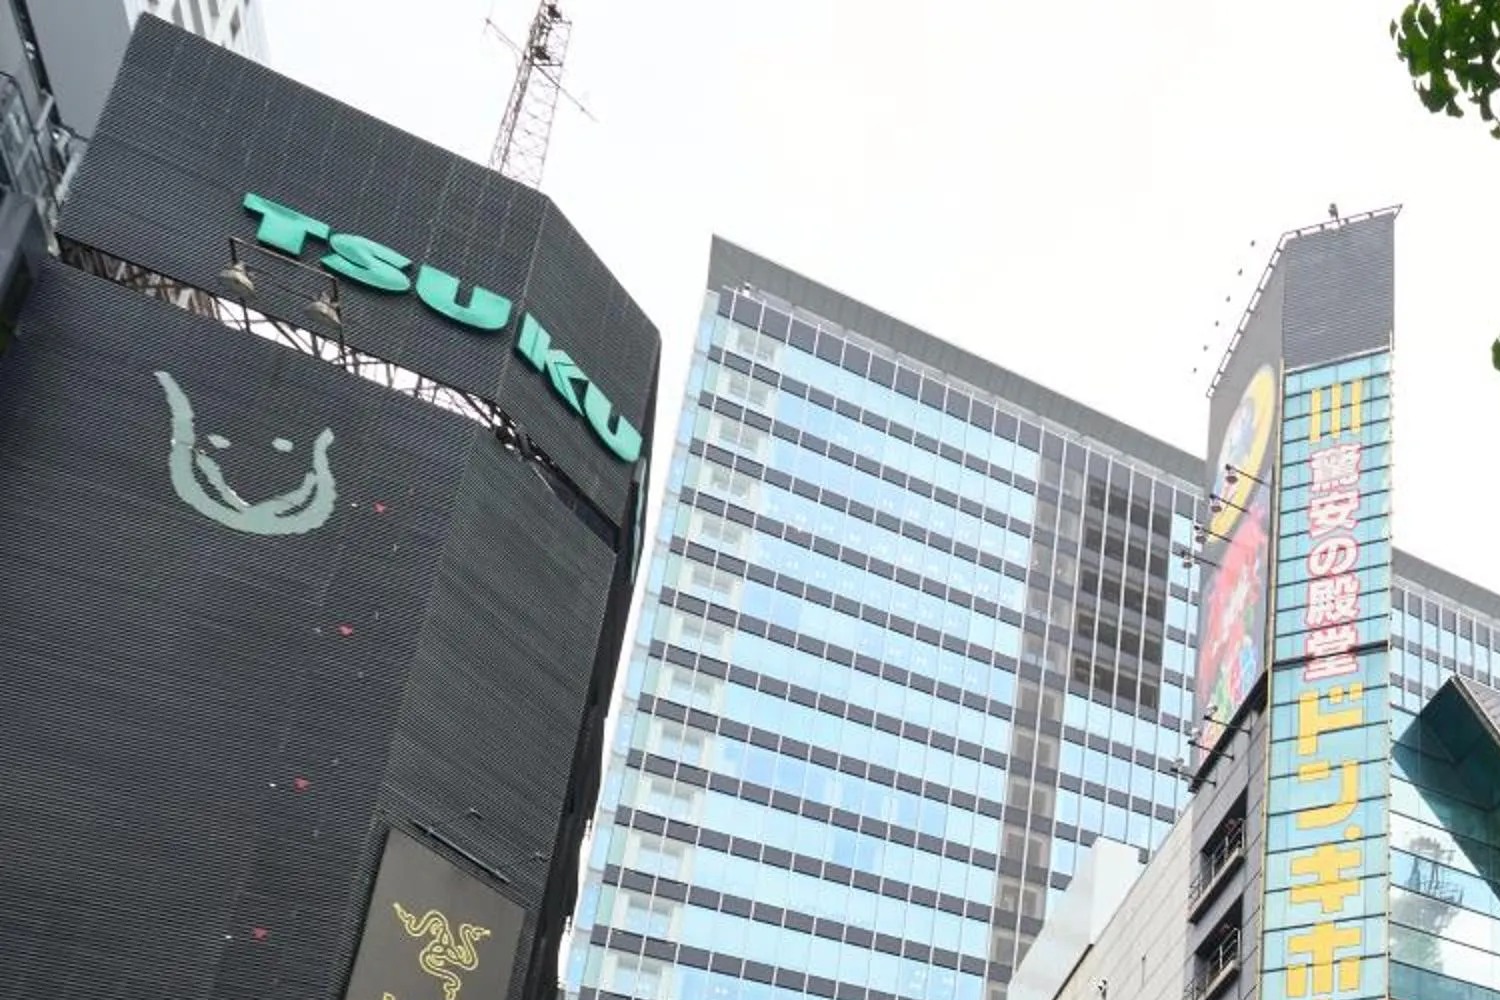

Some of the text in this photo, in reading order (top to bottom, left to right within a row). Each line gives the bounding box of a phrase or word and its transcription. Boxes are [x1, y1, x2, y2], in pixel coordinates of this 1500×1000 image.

[1304, 443, 1362, 681] 驚安の殿堂
